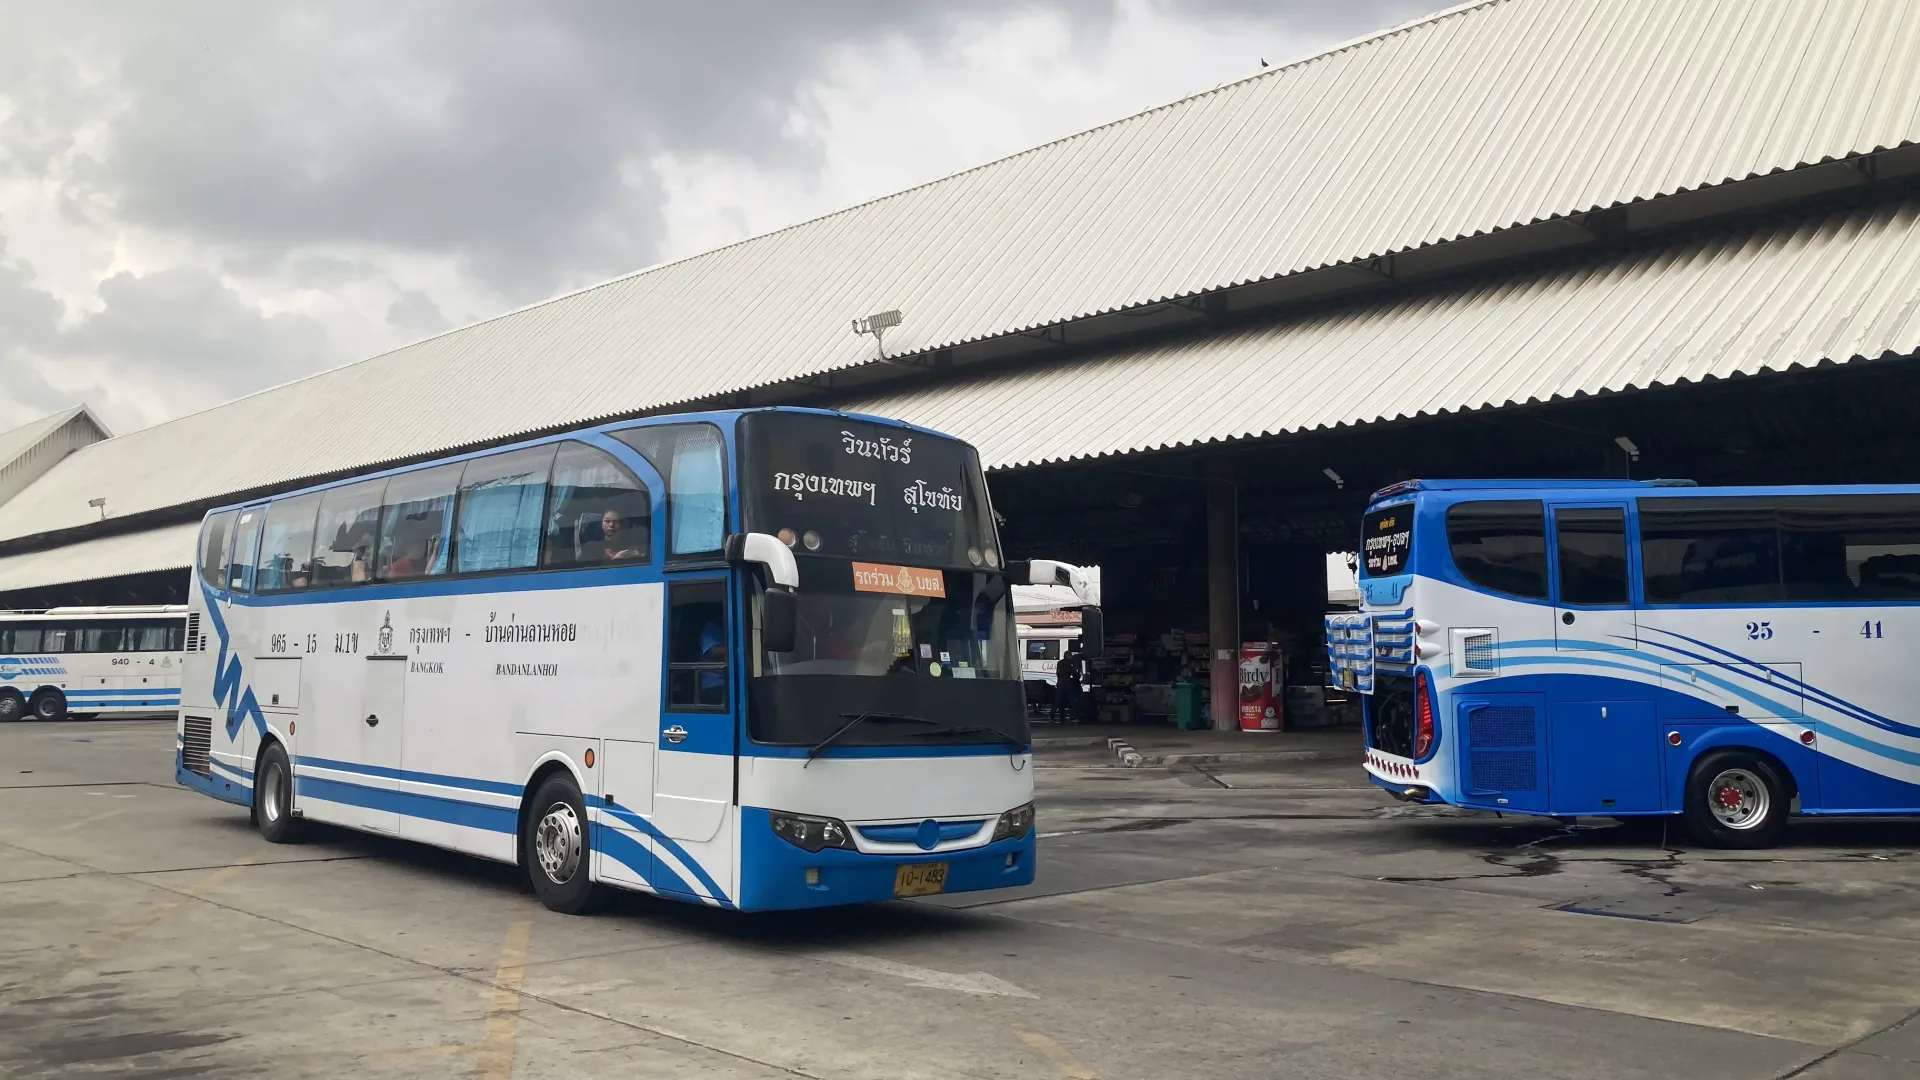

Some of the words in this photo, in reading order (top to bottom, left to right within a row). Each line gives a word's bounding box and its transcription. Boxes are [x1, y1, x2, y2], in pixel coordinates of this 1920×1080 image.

[841, 431, 912, 464] วินทัวร์
[774, 472, 876, 505] กรุงเทพฯ
[904, 479, 962, 513] สุโขทัย
[856, 568, 894, 587] รถร่วม
[916, 576, 944, 591] บขส.
[409, 626, 451, 654] กรุงเทพฯ
[485, 611, 577, 643] บ้านด่านลานหอย
[1746, 621, 1773, 640] 25
[1860, 620, 1884, 639] 41
[271, 633, 287, 653] 965
[306, 633, 317, 653] 15
[112, 658, 130, 666] 940
[410, 662, 444, 674] BANGKOK
[496, 663, 558, 676] BANDANLANHOI
